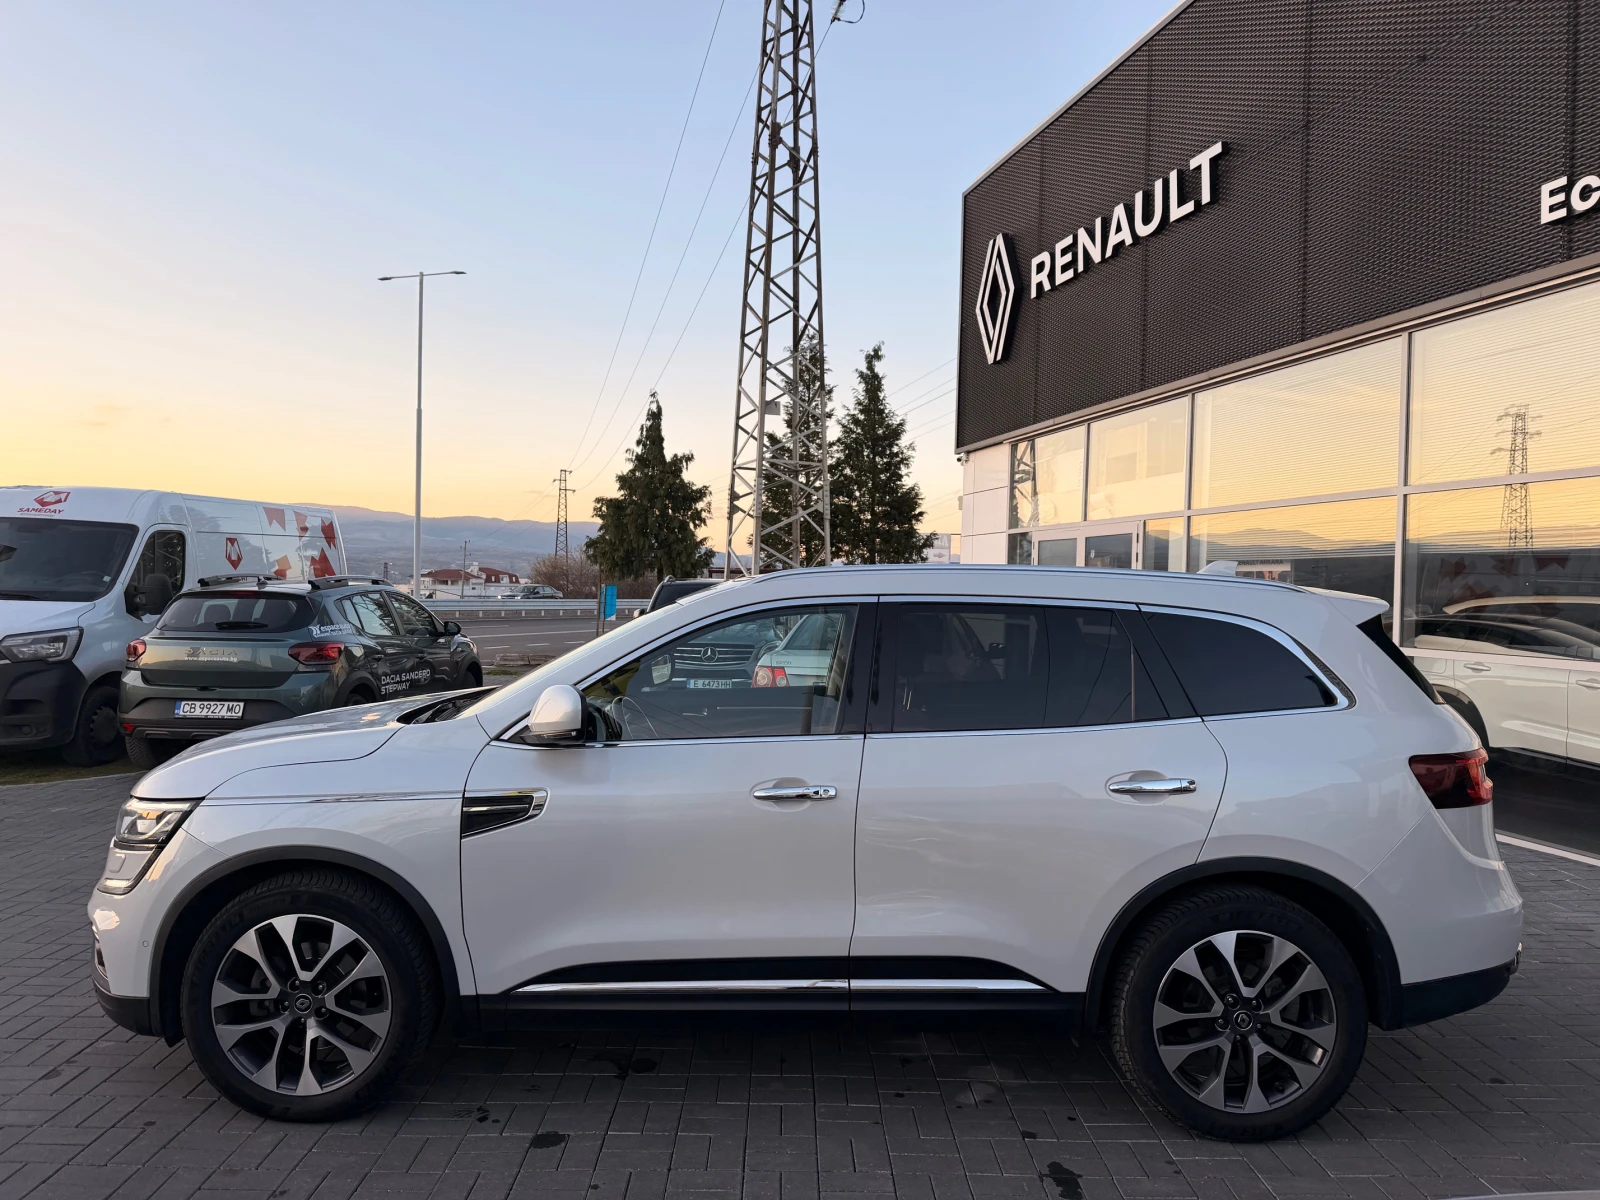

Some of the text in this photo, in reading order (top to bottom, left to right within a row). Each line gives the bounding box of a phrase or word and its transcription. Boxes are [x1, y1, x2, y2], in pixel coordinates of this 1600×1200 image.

[1030, 140, 1223, 300] RENAULT
[381, 669, 431, 685] DACIA SANDERO
[693, 680, 699, 688] E
[701, 680, 720, 688] 6473
[380, 681, 411, 695] STEPWAY
[182, 703, 197, 714] CB
[198, 703, 225, 714] 9927
[225, 703, 242, 715] MO
